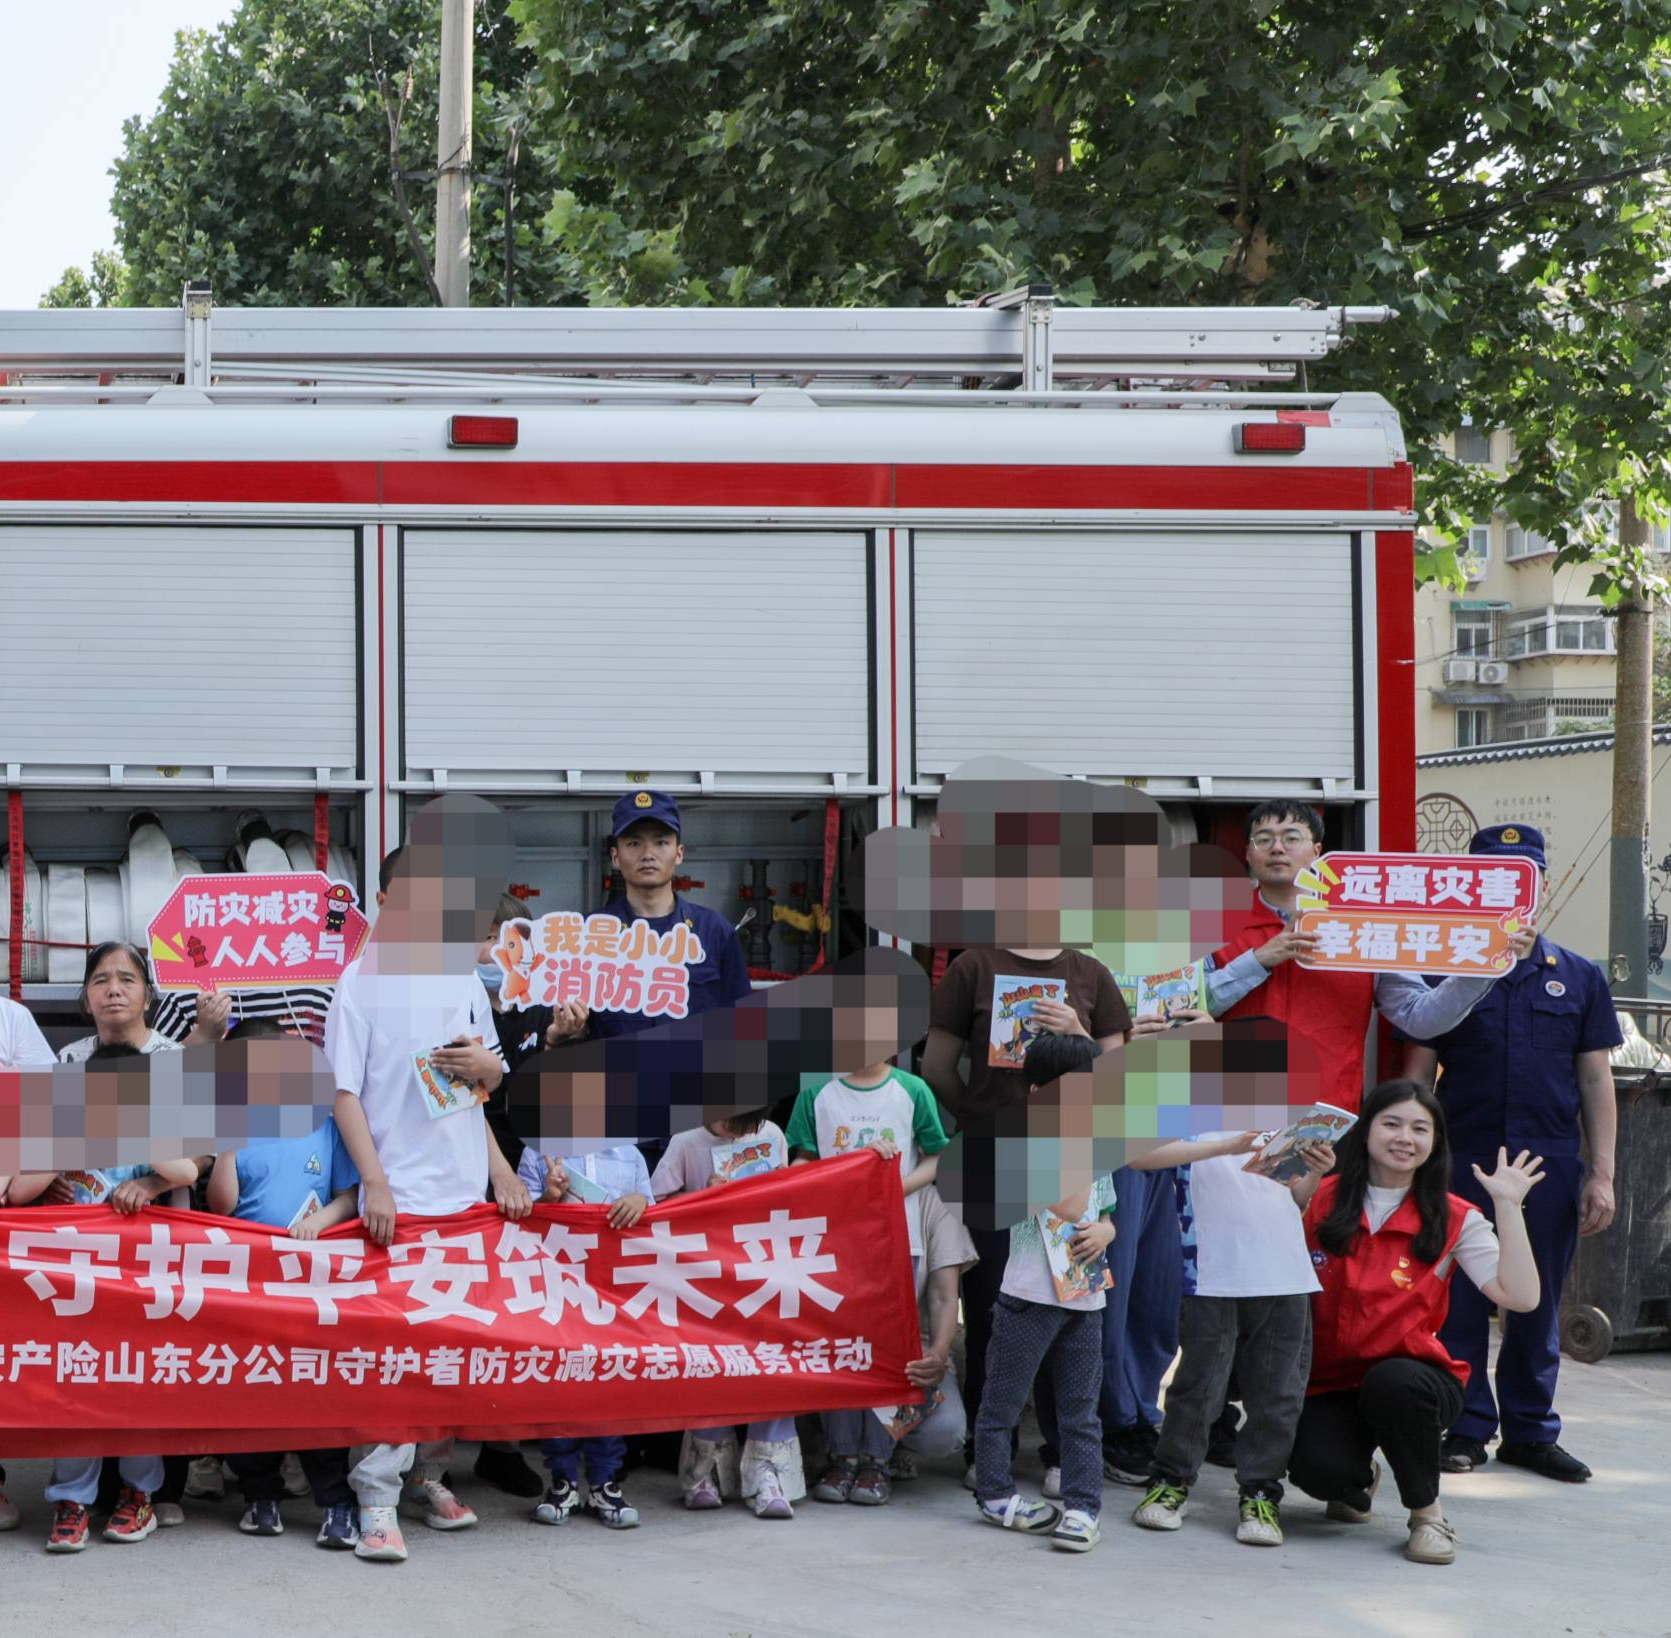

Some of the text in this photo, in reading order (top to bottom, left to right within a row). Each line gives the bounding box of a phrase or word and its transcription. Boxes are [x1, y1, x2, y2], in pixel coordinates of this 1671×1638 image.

[183, 890, 319, 928] 防灾减灾
[1339, 865, 1522, 909] 远离灾害
[211, 931, 346, 970] 人人参与
[543, 915, 701, 965] 我是小小
[1312, 921, 1491, 967] 幸福平安
[543, 957, 690, 1017] 消防员
[7, 1208, 845, 1327] 守护平安筑未来
